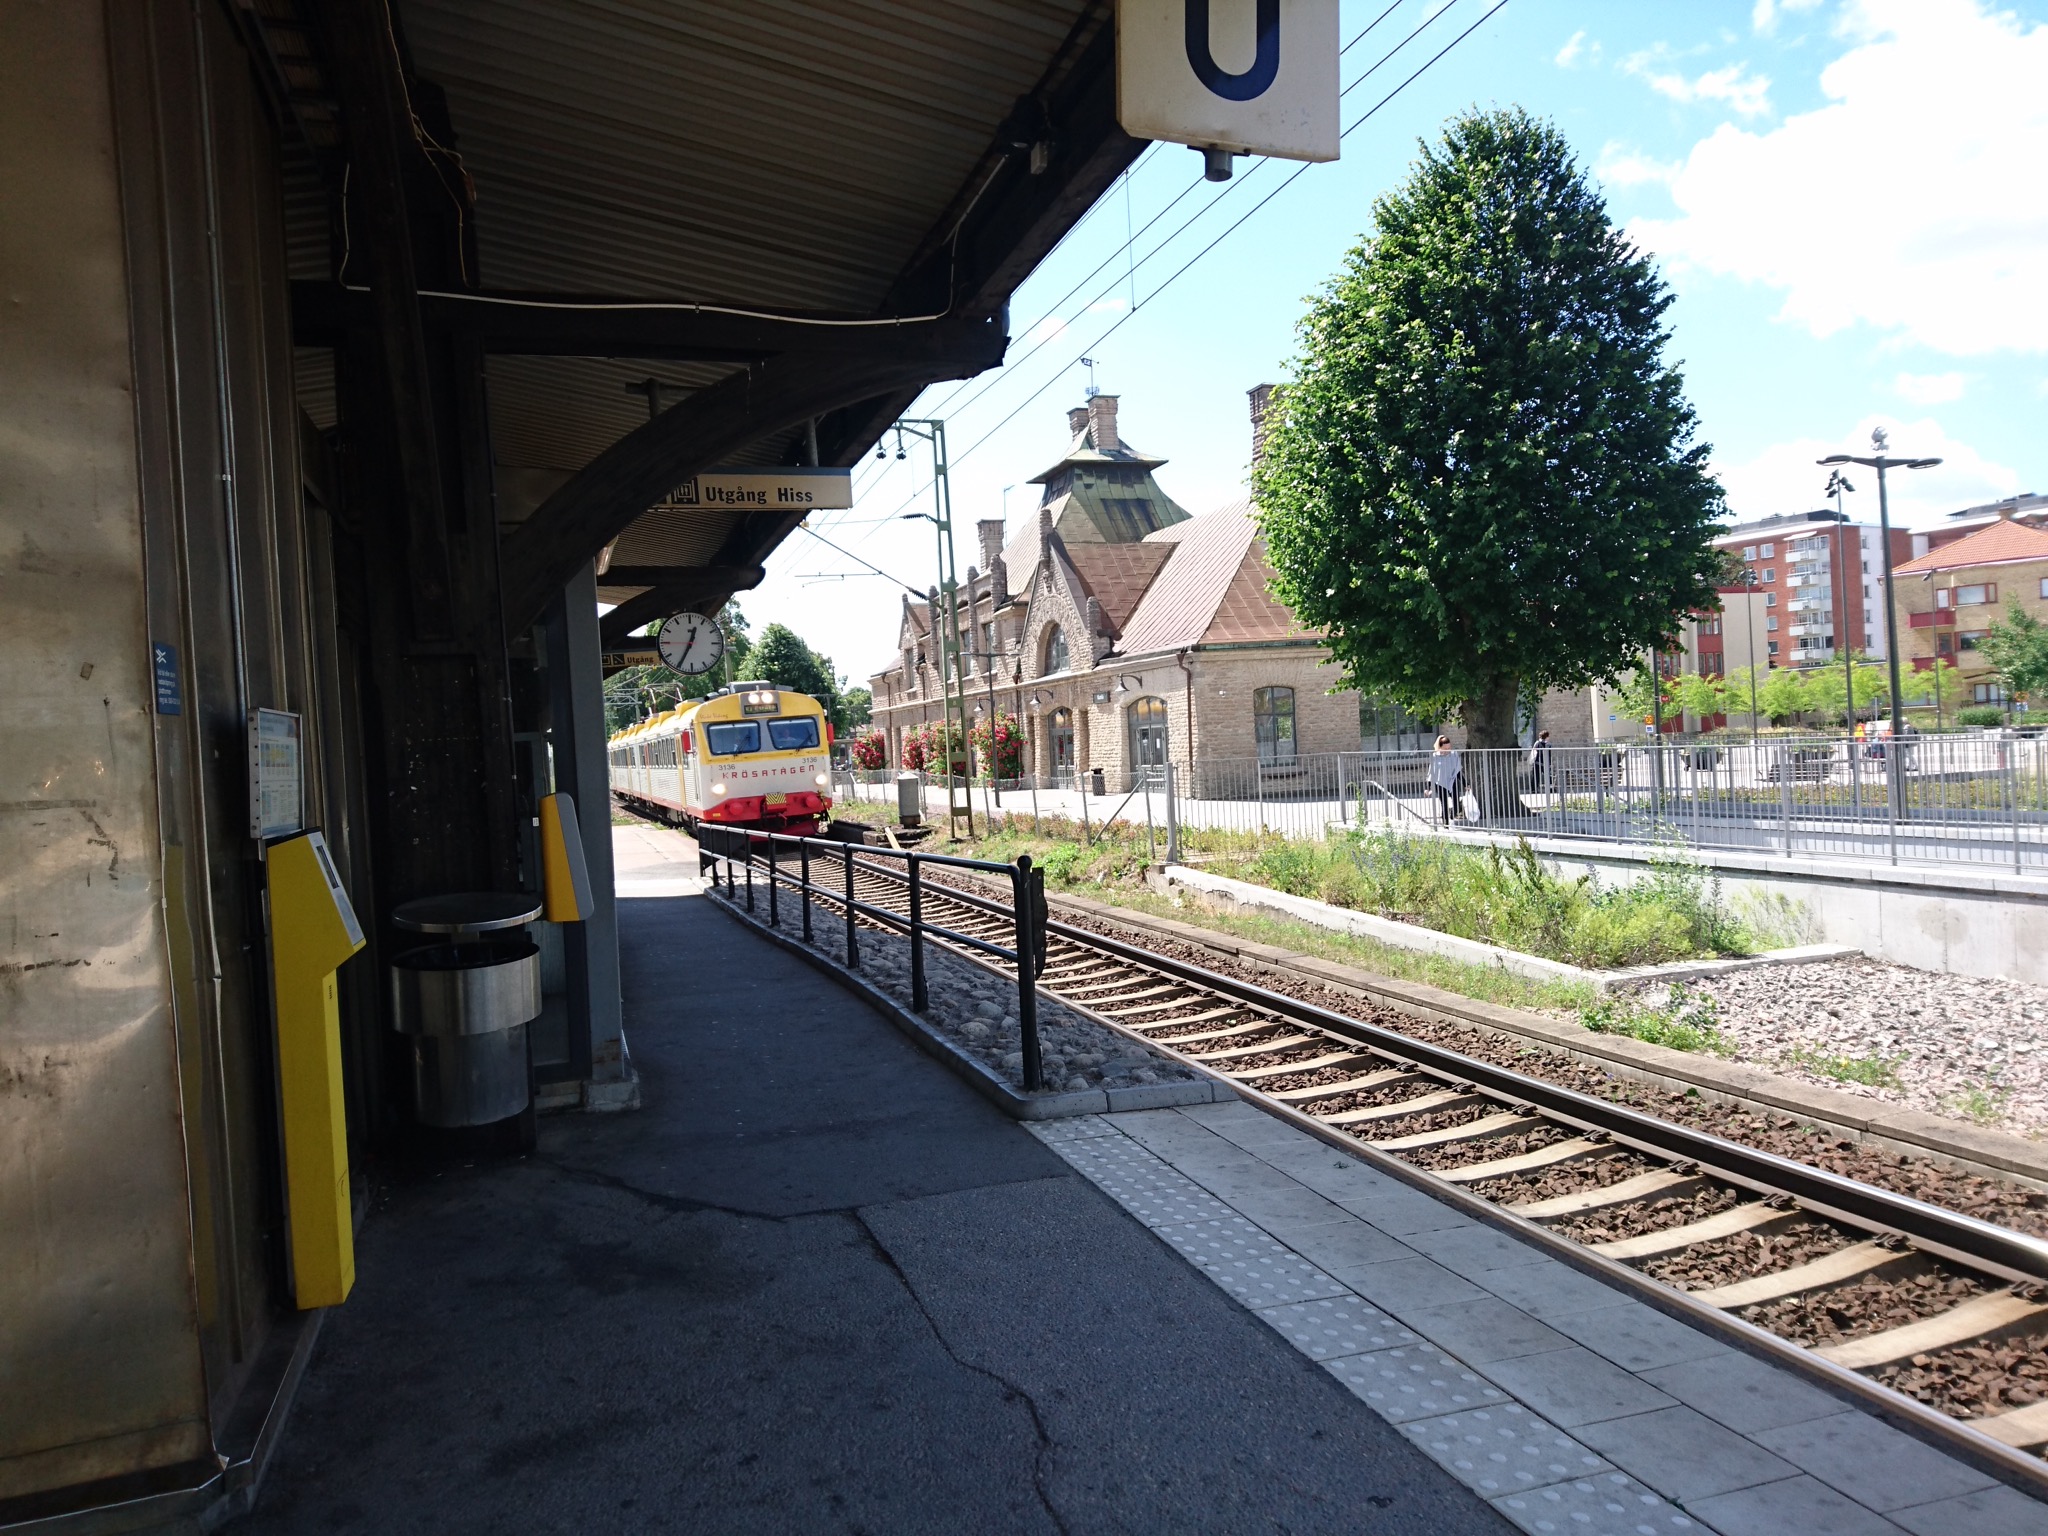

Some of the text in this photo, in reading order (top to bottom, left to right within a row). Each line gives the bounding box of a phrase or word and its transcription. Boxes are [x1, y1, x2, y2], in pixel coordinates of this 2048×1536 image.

[705, 486, 813, 504] Utgång Hiss
[627, 655, 654, 664] Utgång
[722, 764, 815, 779] KRÖSATÅGEN
